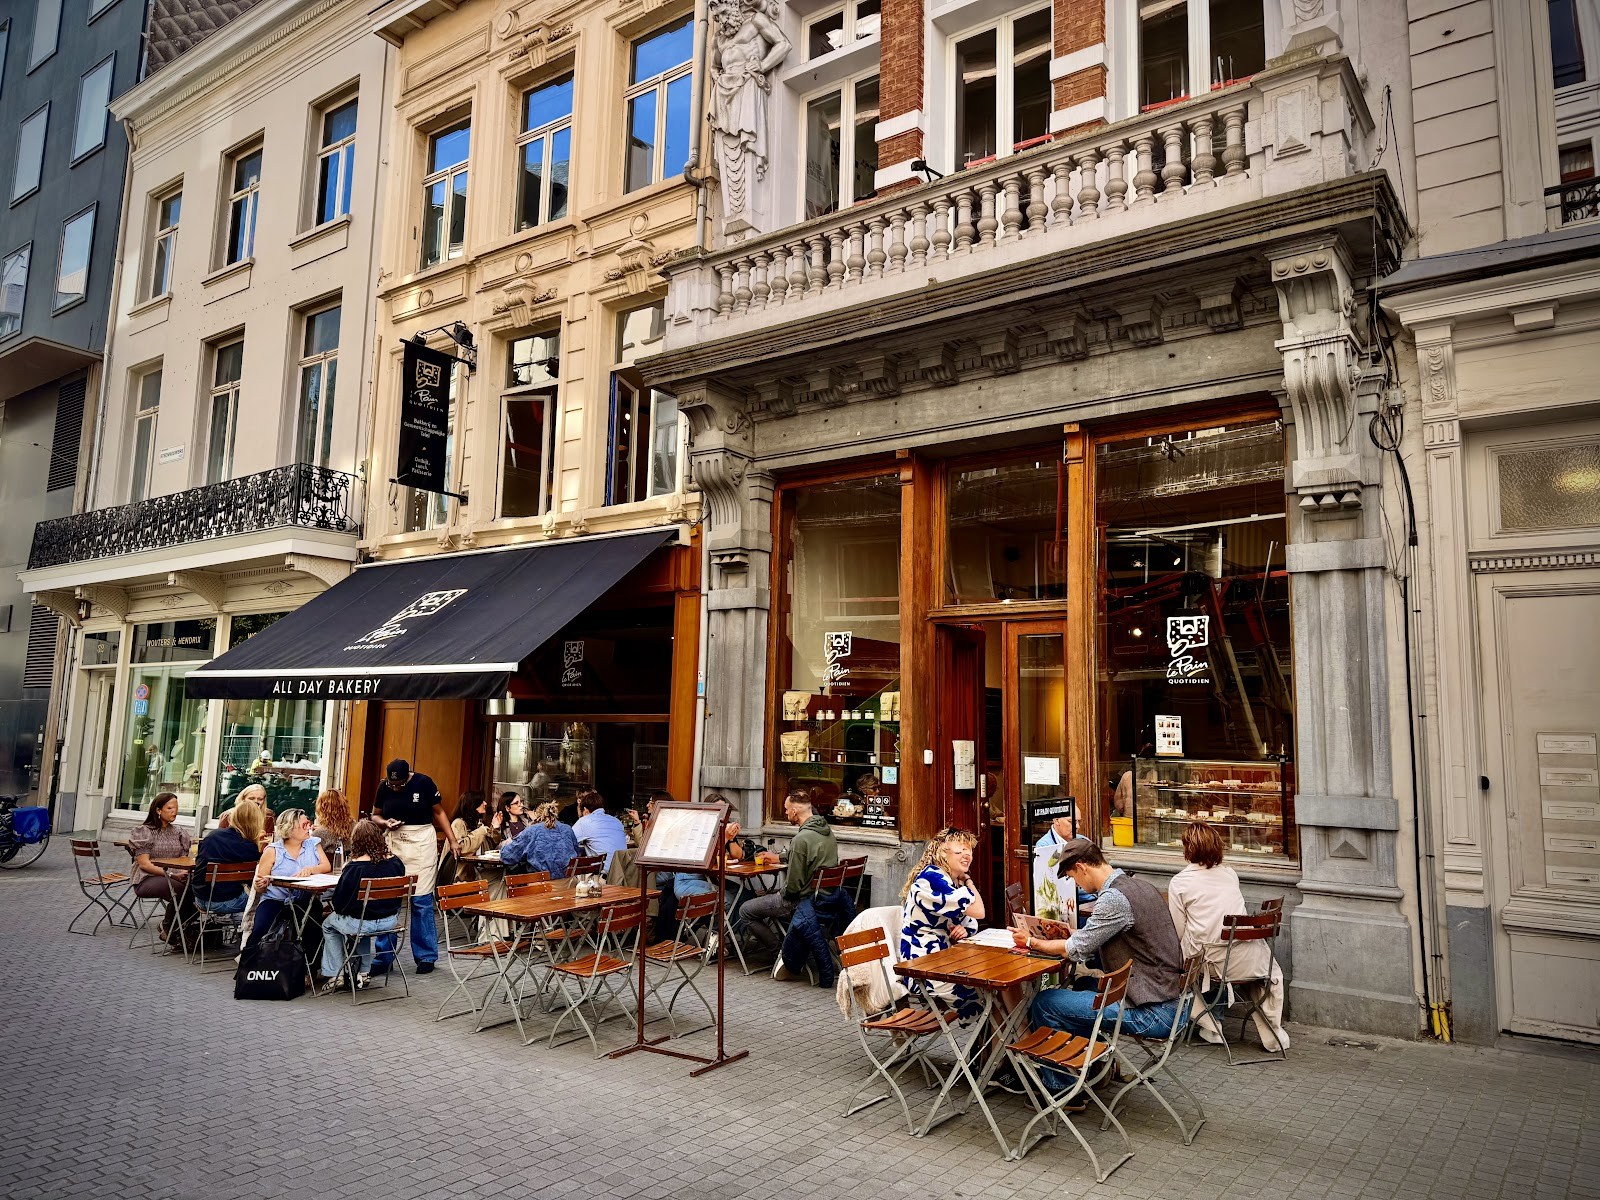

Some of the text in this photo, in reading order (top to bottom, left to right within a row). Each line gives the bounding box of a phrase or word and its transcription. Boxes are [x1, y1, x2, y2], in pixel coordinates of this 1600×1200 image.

[146, 638, 171, 647] WOUTERS
[828, 662, 851, 680] Pain
[1173, 655, 1209, 677] Pain
[272, 678, 381, 694] ALL DAY BAKERY
[247, 970, 280, 981] ONLY
